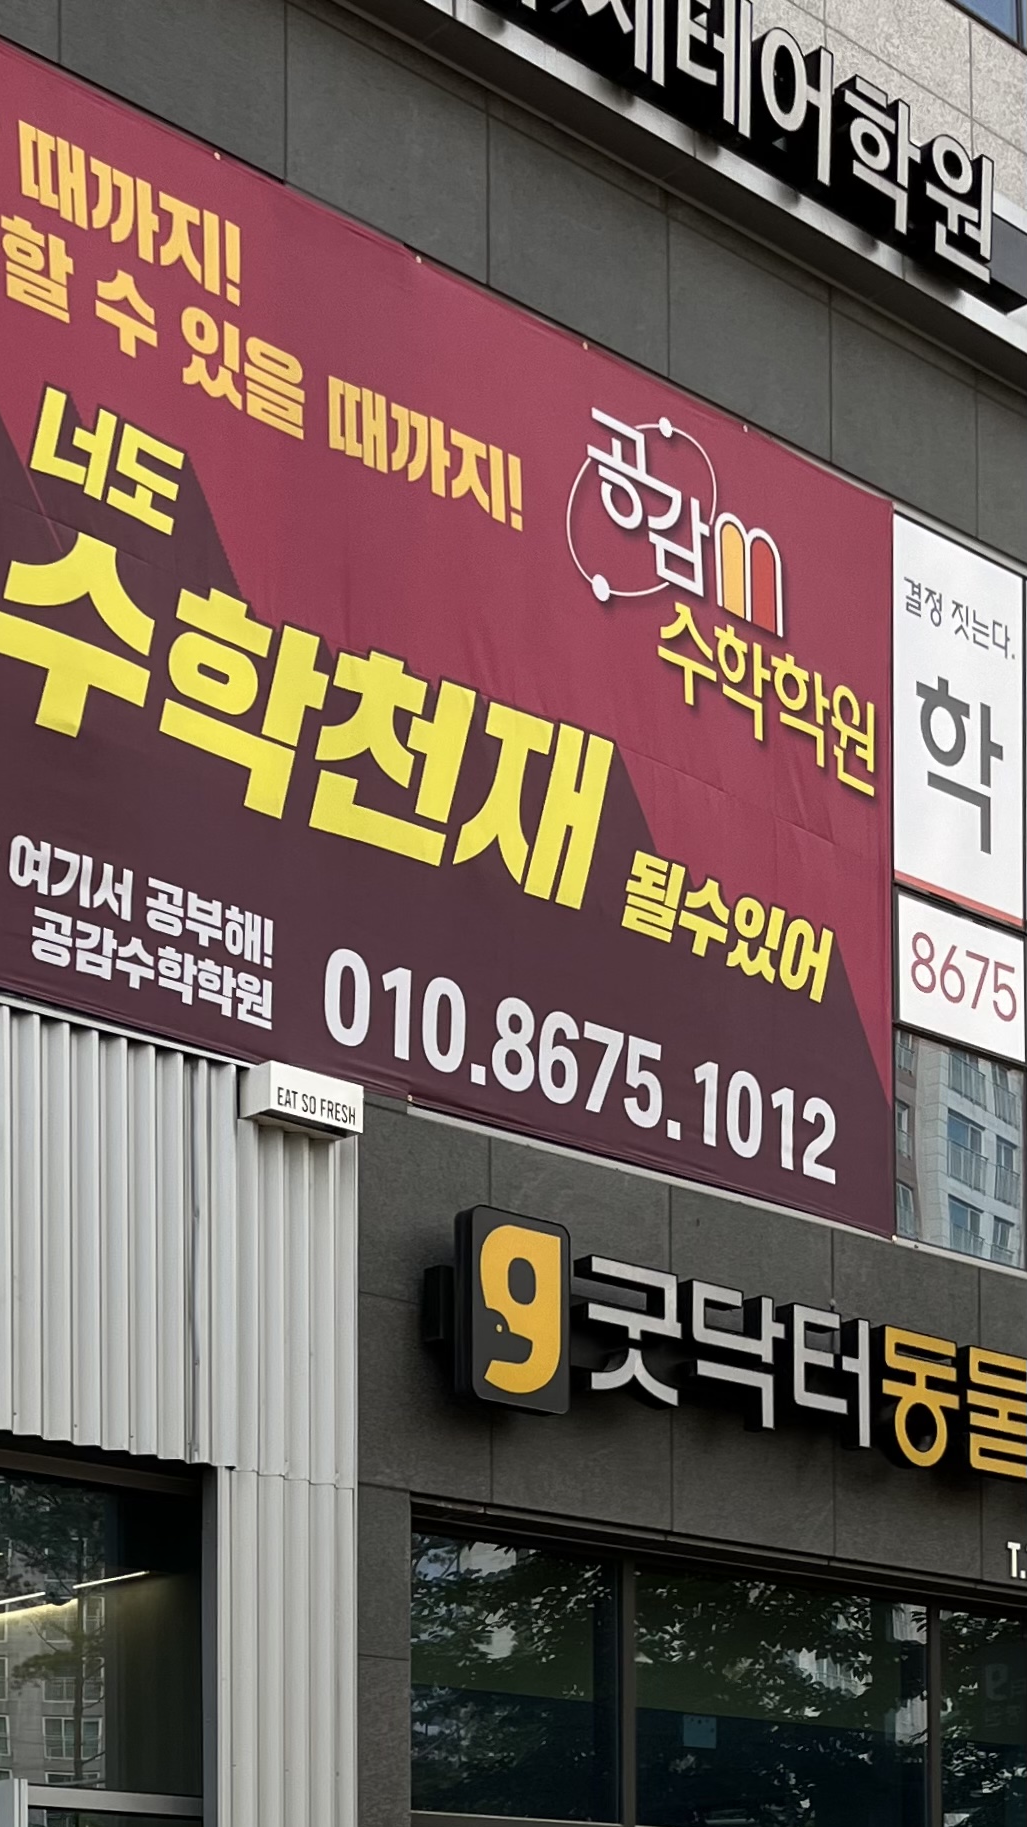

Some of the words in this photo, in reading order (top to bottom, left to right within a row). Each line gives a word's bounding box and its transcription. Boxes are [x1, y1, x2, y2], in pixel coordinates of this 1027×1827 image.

[17, 118, 242, 307] 때까지!
[28, 386, 185, 537] 너도
[94, 268, 159, 359] 수
[180, 306, 306, 440] 있을
[327, 375, 524, 532] 때까지!
[903, 576, 942, 628] 결정
[951, 599, 1016, 660] 짓는다.
[657, 601, 875, 798] 수학학원
[914, 675, 1004, 855] 학
[8, 833, 134, 921] 여기서
[144, 876, 275, 968] 공부해!
[30, 905, 274, 1031] 공감수학학원
[620, 850, 836, 1004] 될수있어
[910, 931, 1018, 1023] 8675
[277, 1086, 298, 1109] EAT
[301, 1093, 317, 1115] SO
[320, 1098, 356, 1126] FRESH
[323, 948, 837, 1186] 010.8675.1012
